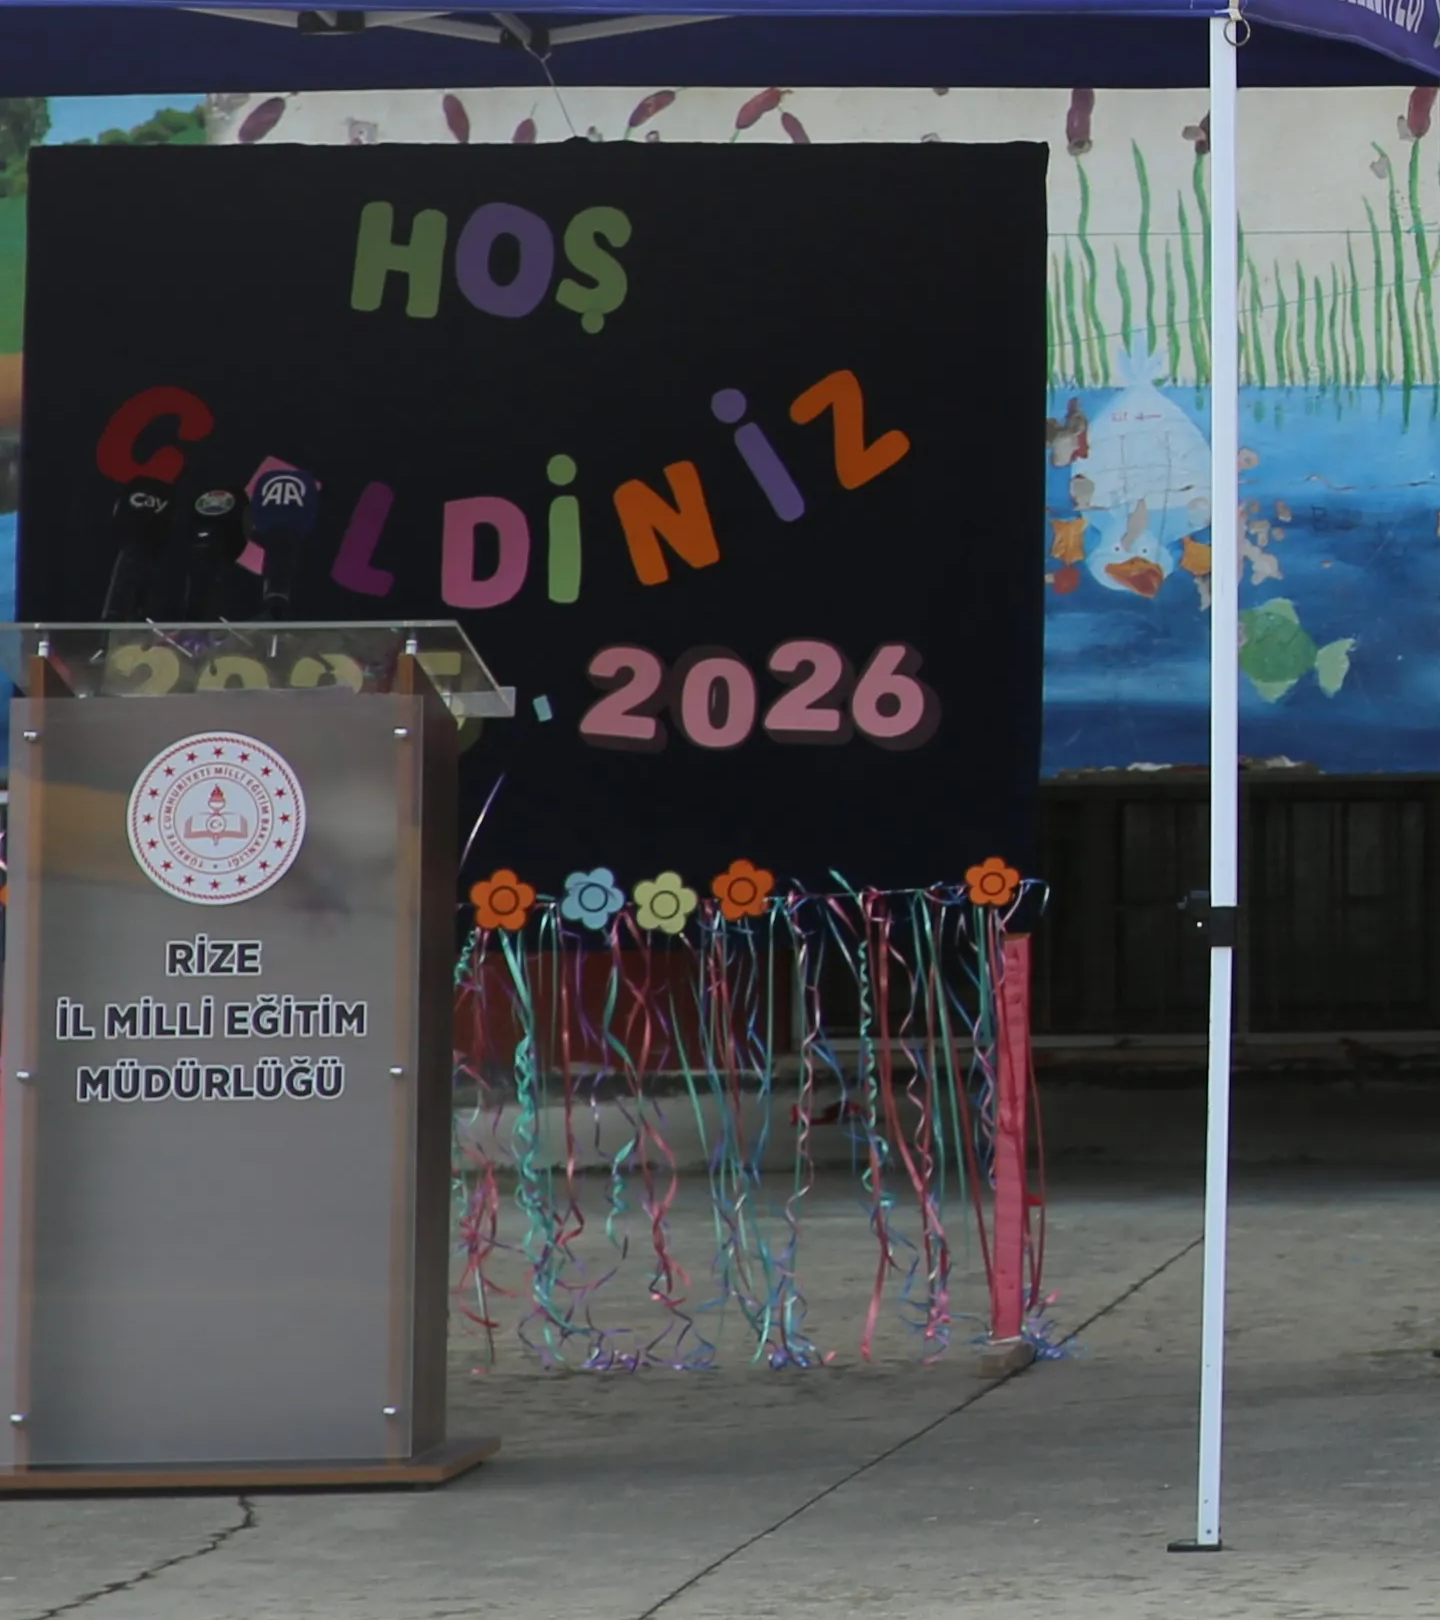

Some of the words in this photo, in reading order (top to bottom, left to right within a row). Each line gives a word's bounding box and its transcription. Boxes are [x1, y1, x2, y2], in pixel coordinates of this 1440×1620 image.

[350, 200, 633, 334] HOŞ
[261, 475, 306, 508] AA
[579, 640, 930, 750] 2026
[214, 766, 246, 780] MİLLİ
[166, 934, 262, 977] RİZE
[56, 997, 95, 1039] İL
[104, 996, 214, 1039] MİLLİ
[224, 994, 367, 1037] EĞİTİM
[76, 1056, 346, 1103] MÜDÜRLÜĞÜ
